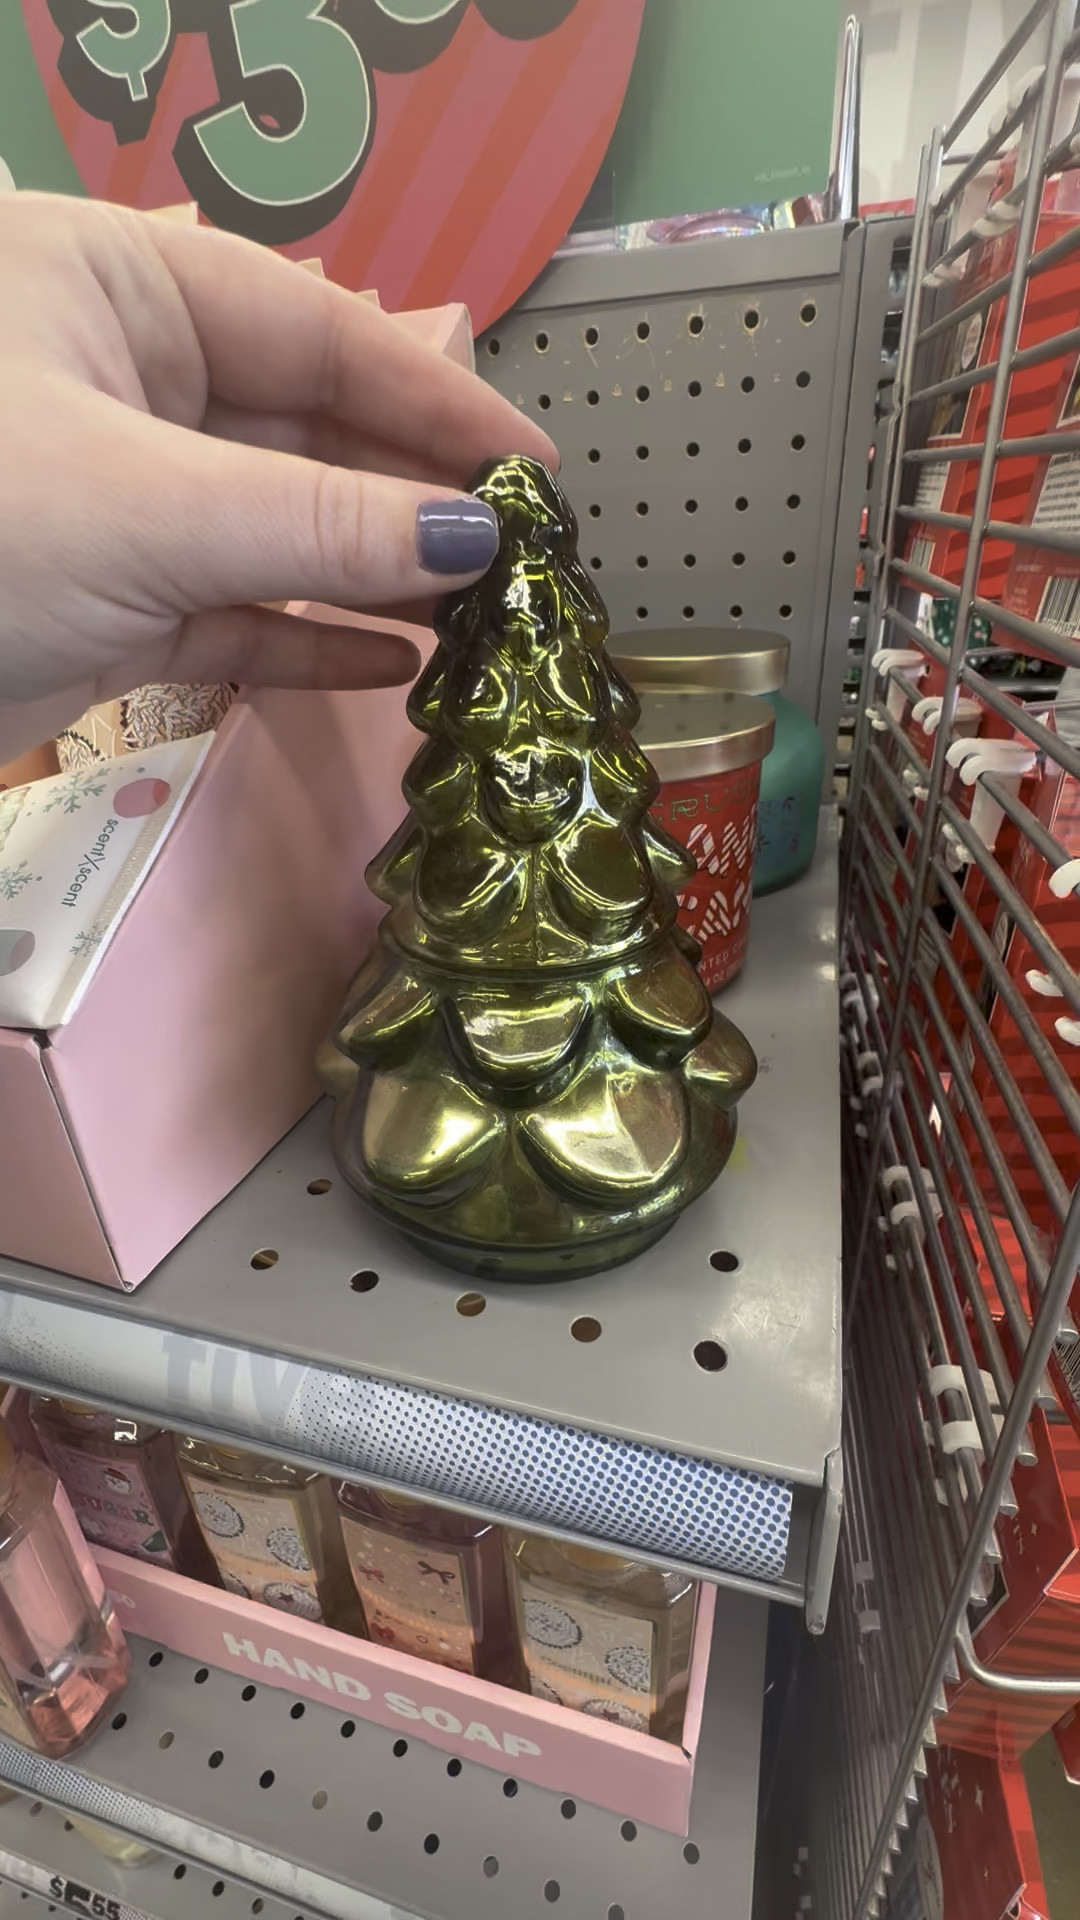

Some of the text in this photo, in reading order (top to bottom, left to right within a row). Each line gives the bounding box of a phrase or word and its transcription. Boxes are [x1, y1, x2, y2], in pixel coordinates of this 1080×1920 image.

[76, 0, 460, 206] $3
[222, 1632, 542, 1757] HAND SOAP
